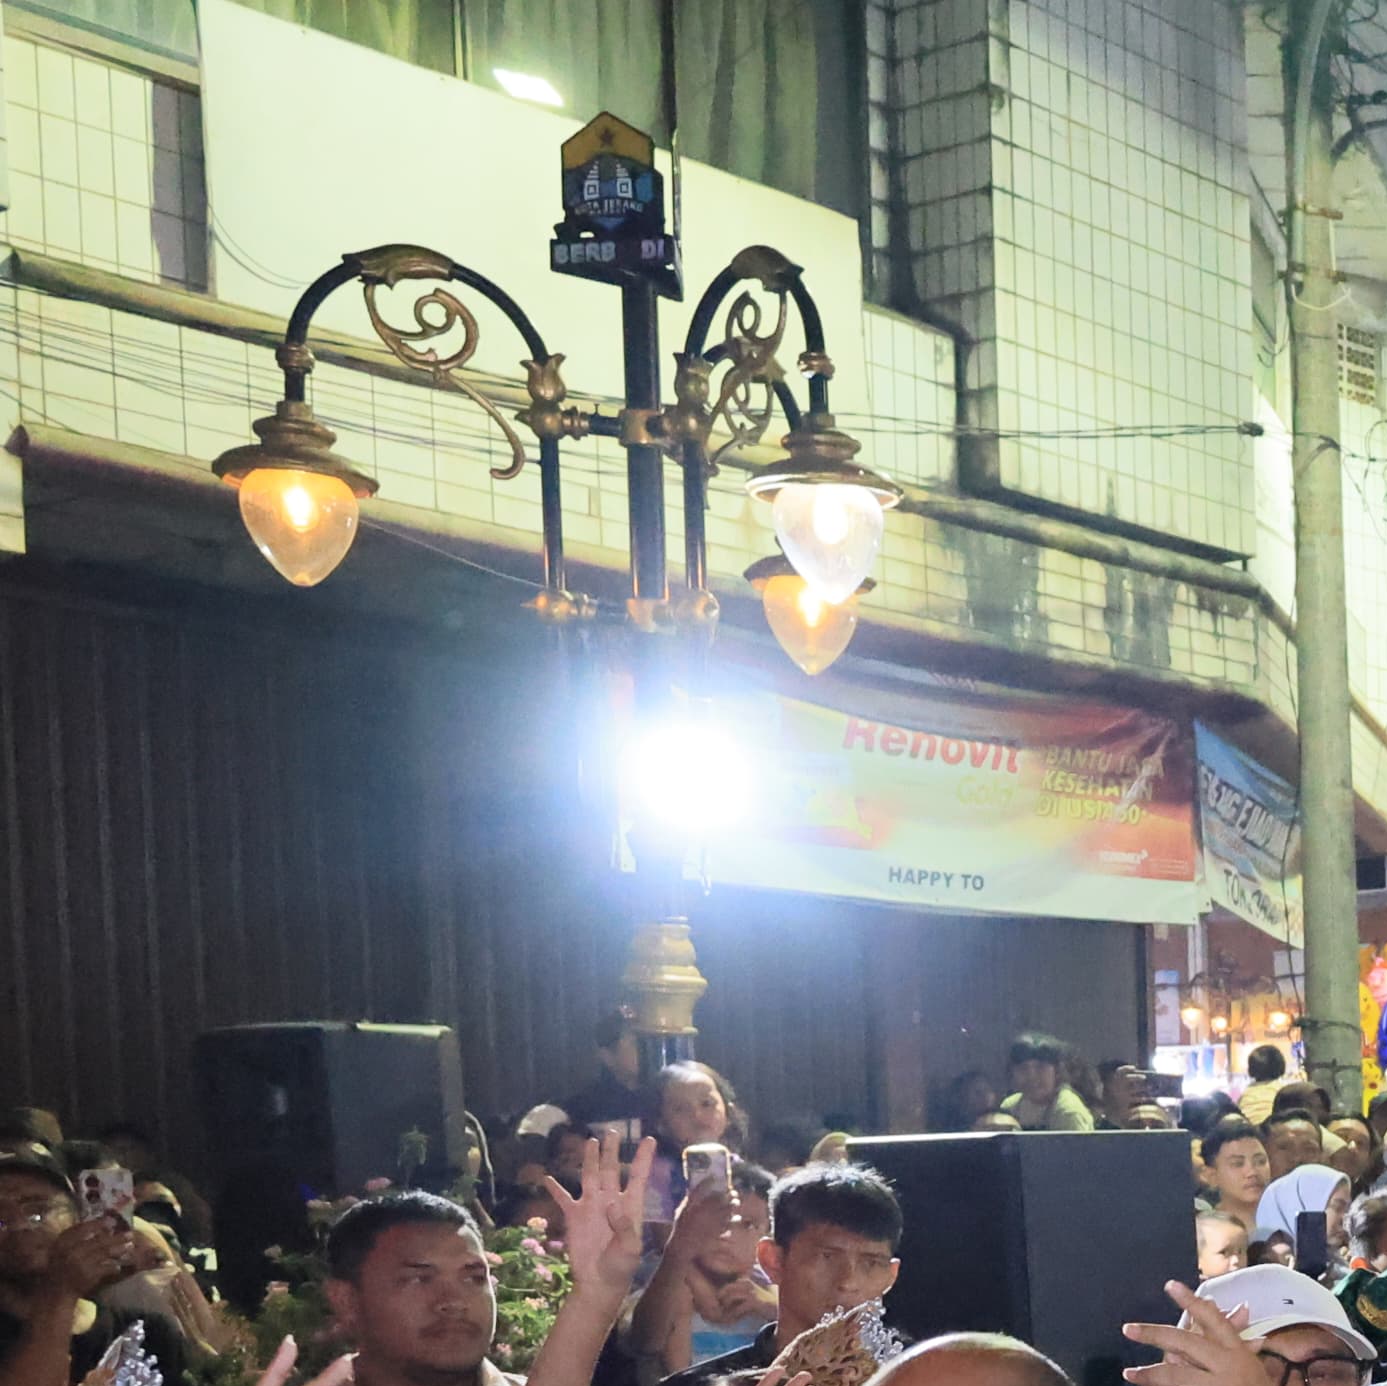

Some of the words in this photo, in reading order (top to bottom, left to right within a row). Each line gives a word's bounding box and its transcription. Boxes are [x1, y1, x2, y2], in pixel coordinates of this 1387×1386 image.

[842, 717, 1021, 775] Renovit
[888, 865, 953, 889] HAPPY
[961, 873, 985, 891] TO
